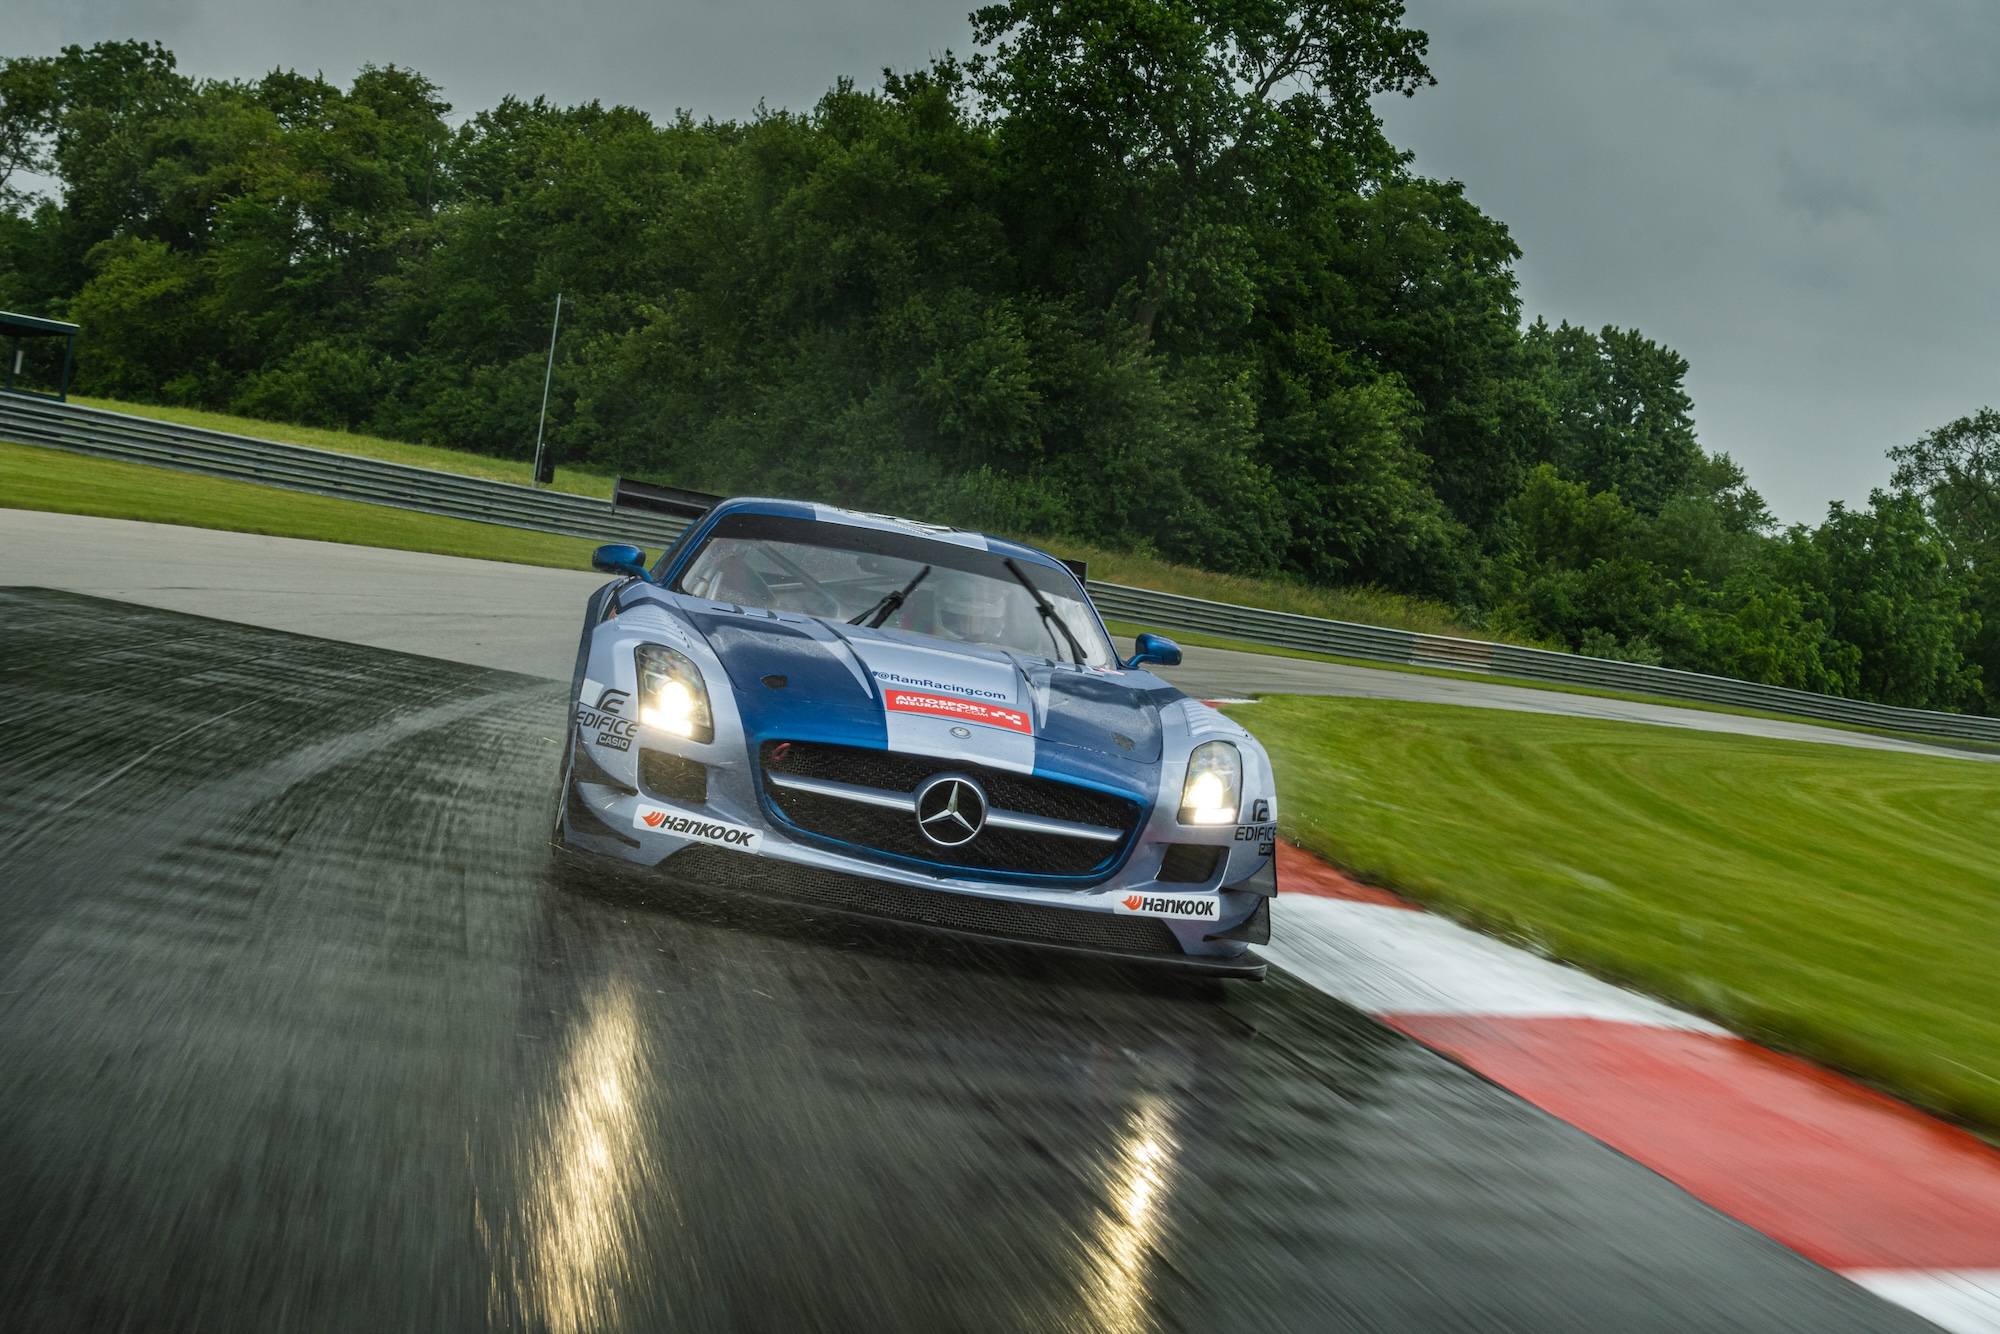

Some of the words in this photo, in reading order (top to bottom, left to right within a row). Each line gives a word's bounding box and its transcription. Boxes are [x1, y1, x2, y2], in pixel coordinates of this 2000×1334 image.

[877, 671, 1006, 700] @RamRacingcom
[896, 695, 987, 713] AUTOSPORT
[896, 701, 989, 718] INSURANCE.COM
[576, 710, 640, 738] EDIFICE
[599, 734, 629, 749] CASIO
